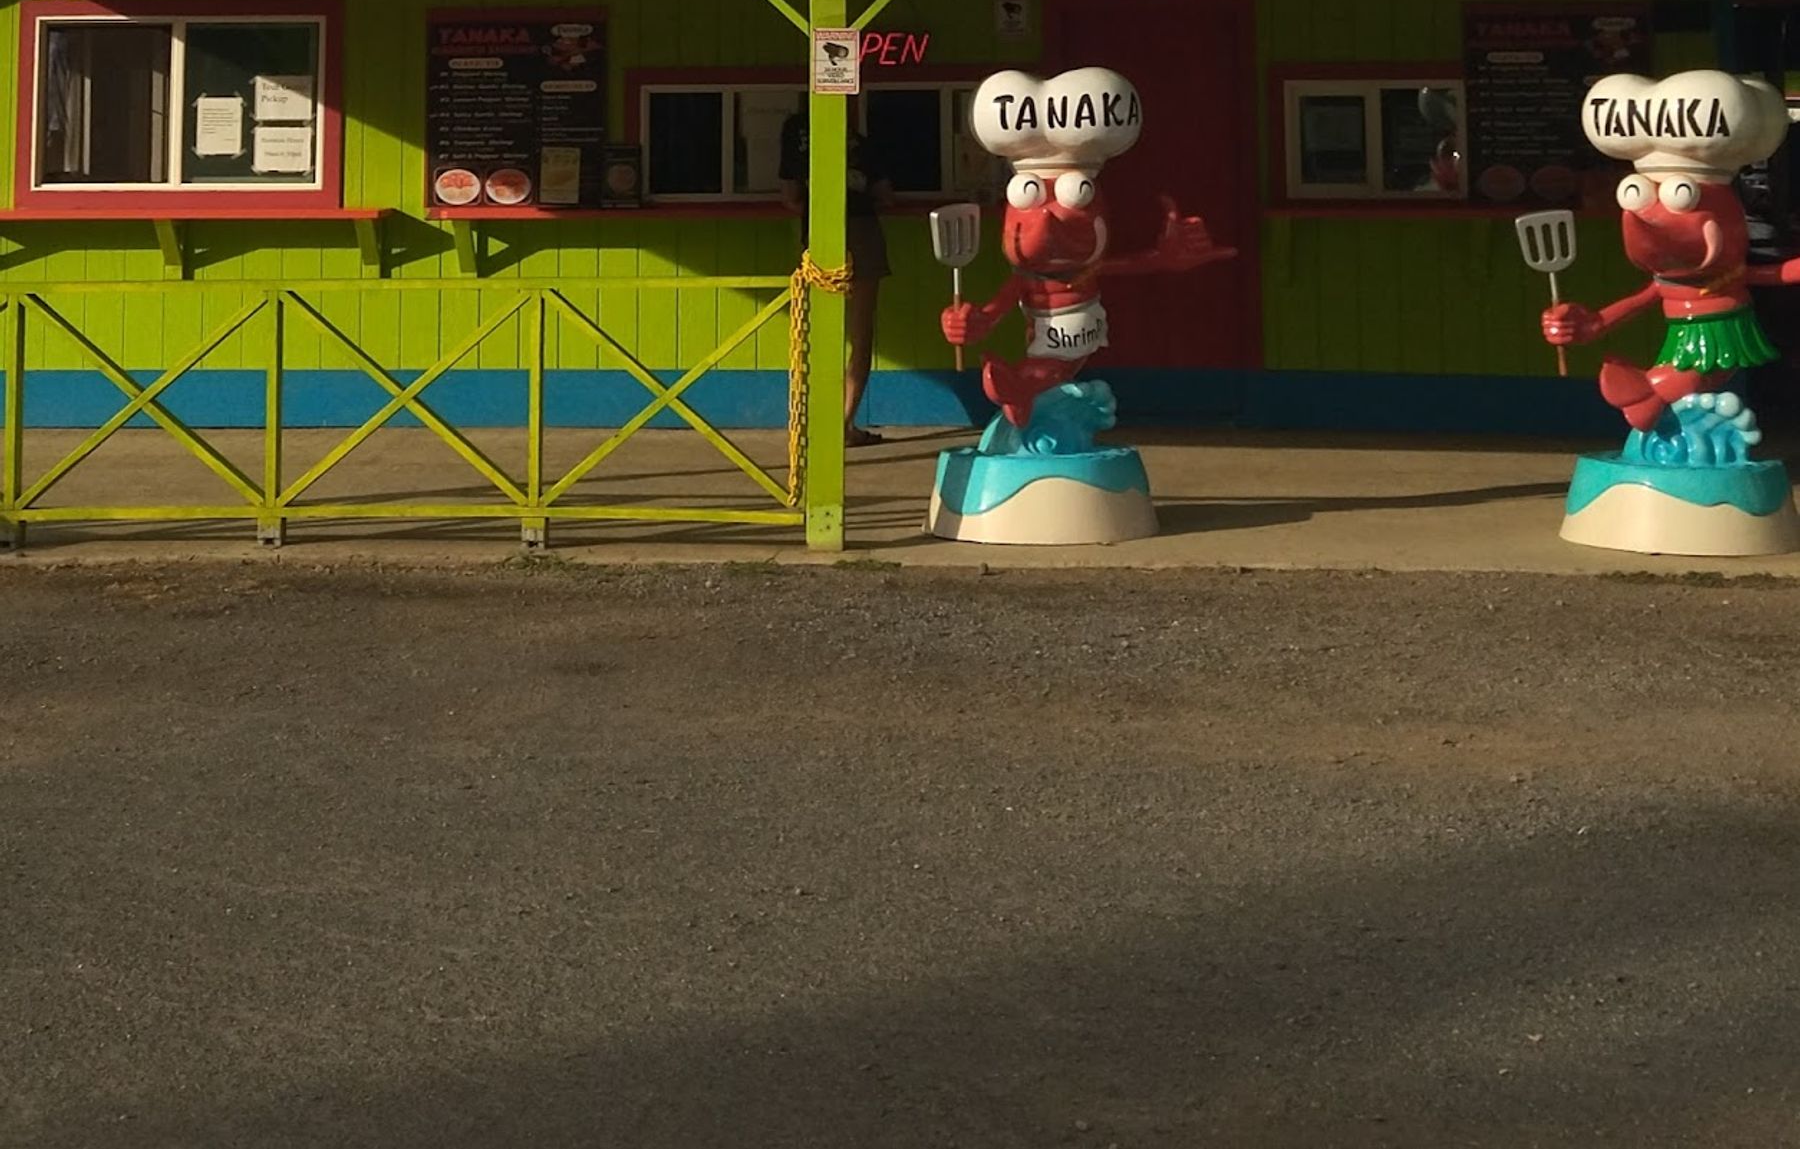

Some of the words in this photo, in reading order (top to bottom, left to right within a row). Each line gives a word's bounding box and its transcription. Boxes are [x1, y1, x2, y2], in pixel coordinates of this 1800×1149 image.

[859, 32, 930, 65] PEN
[993, 92, 1139, 131] TANAKA
[1590, 98, 1730, 137] TANAKA
